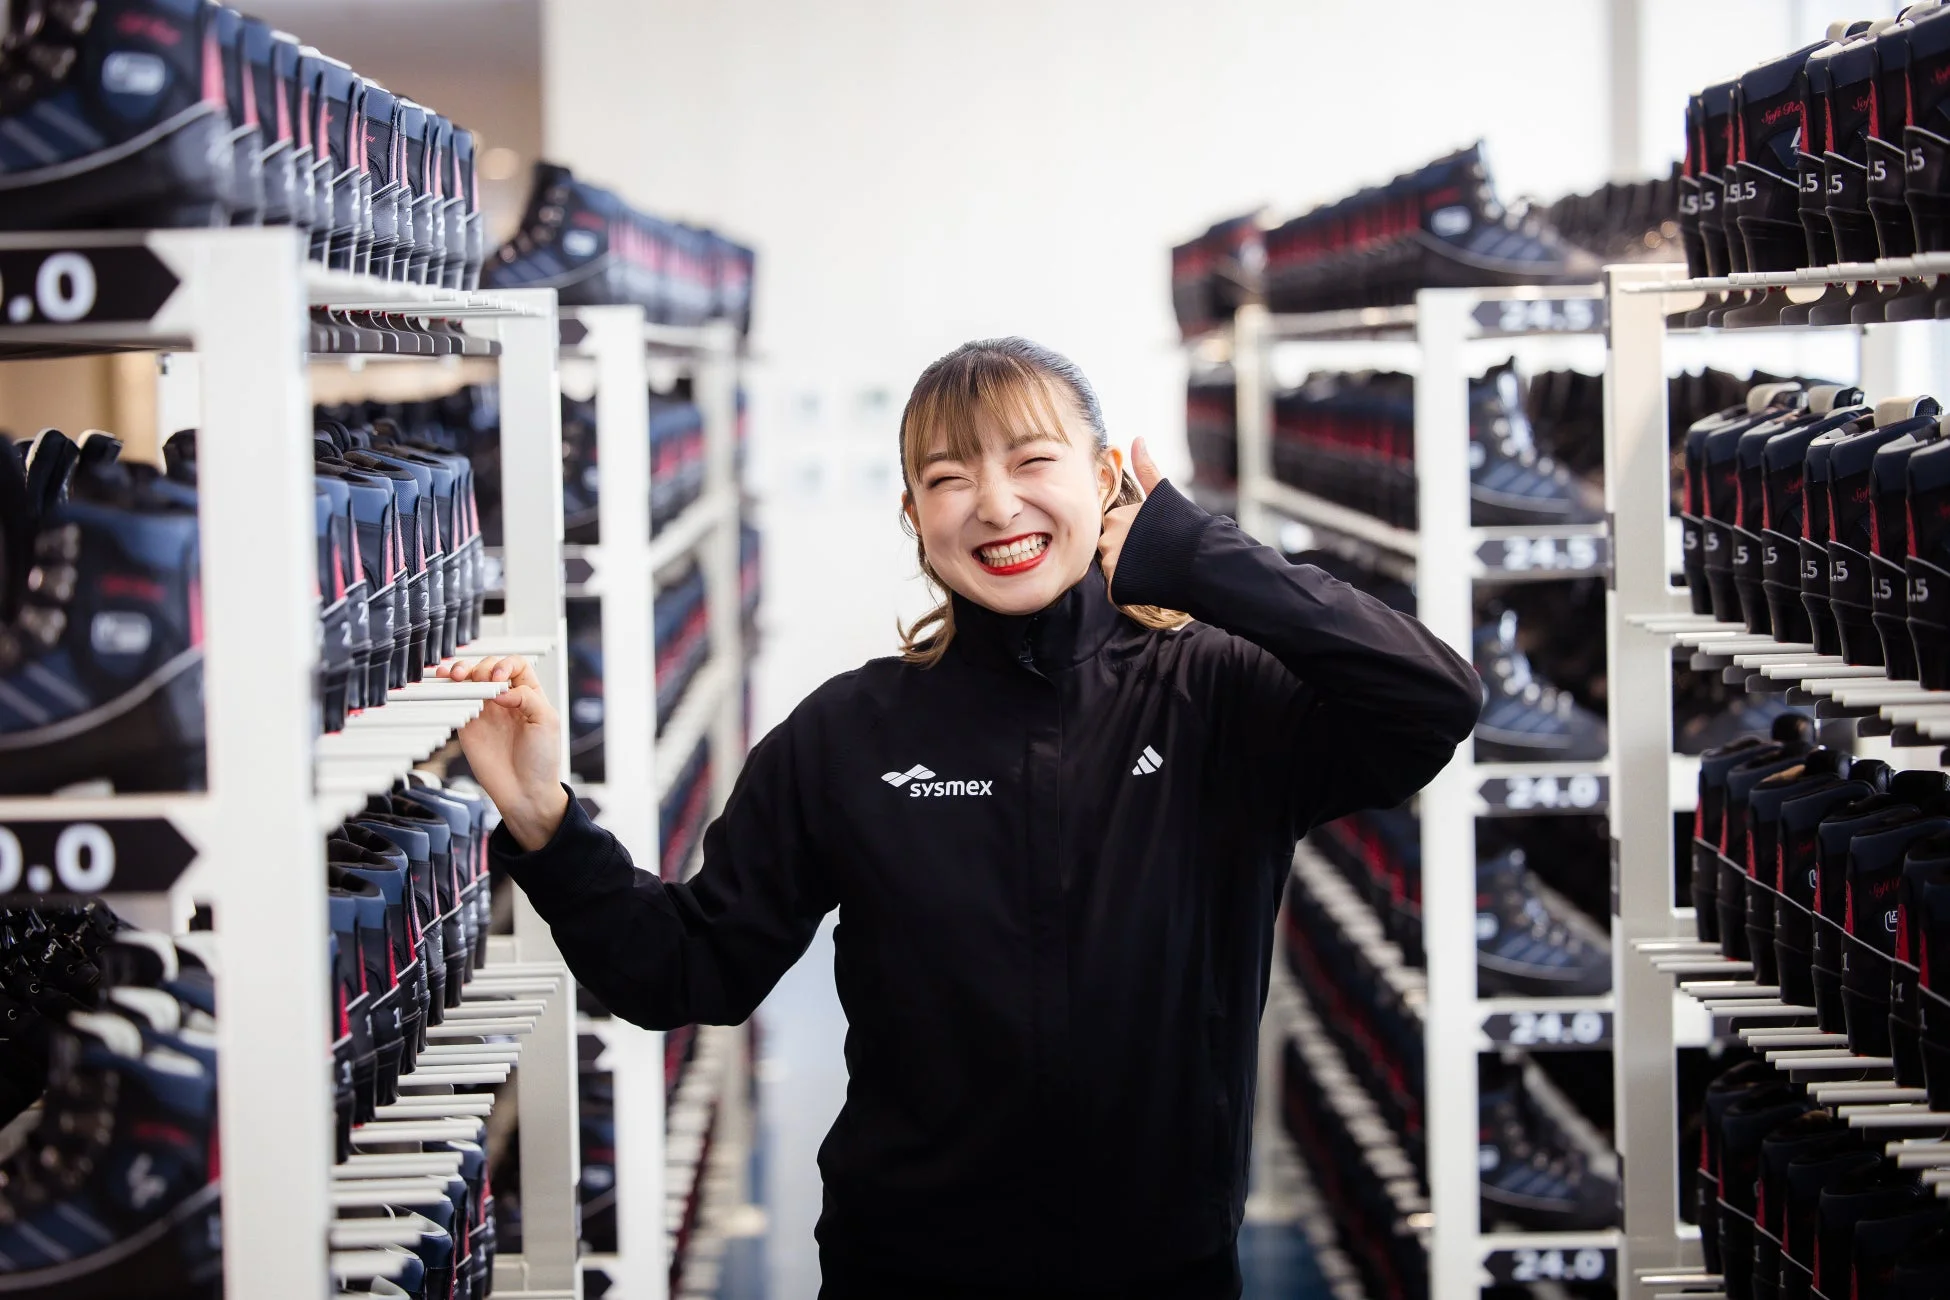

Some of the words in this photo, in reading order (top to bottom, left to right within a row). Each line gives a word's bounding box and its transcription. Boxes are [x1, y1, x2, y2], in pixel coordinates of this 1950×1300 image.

[0, 252, 97, 322] .0
[909, 780, 993, 798] sysmex
[1506, 774, 1600, 809] 24.0
[1510, 1011, 1603, 1044] 24.0
[1512, 1248, 1605, 1280] 24.0
